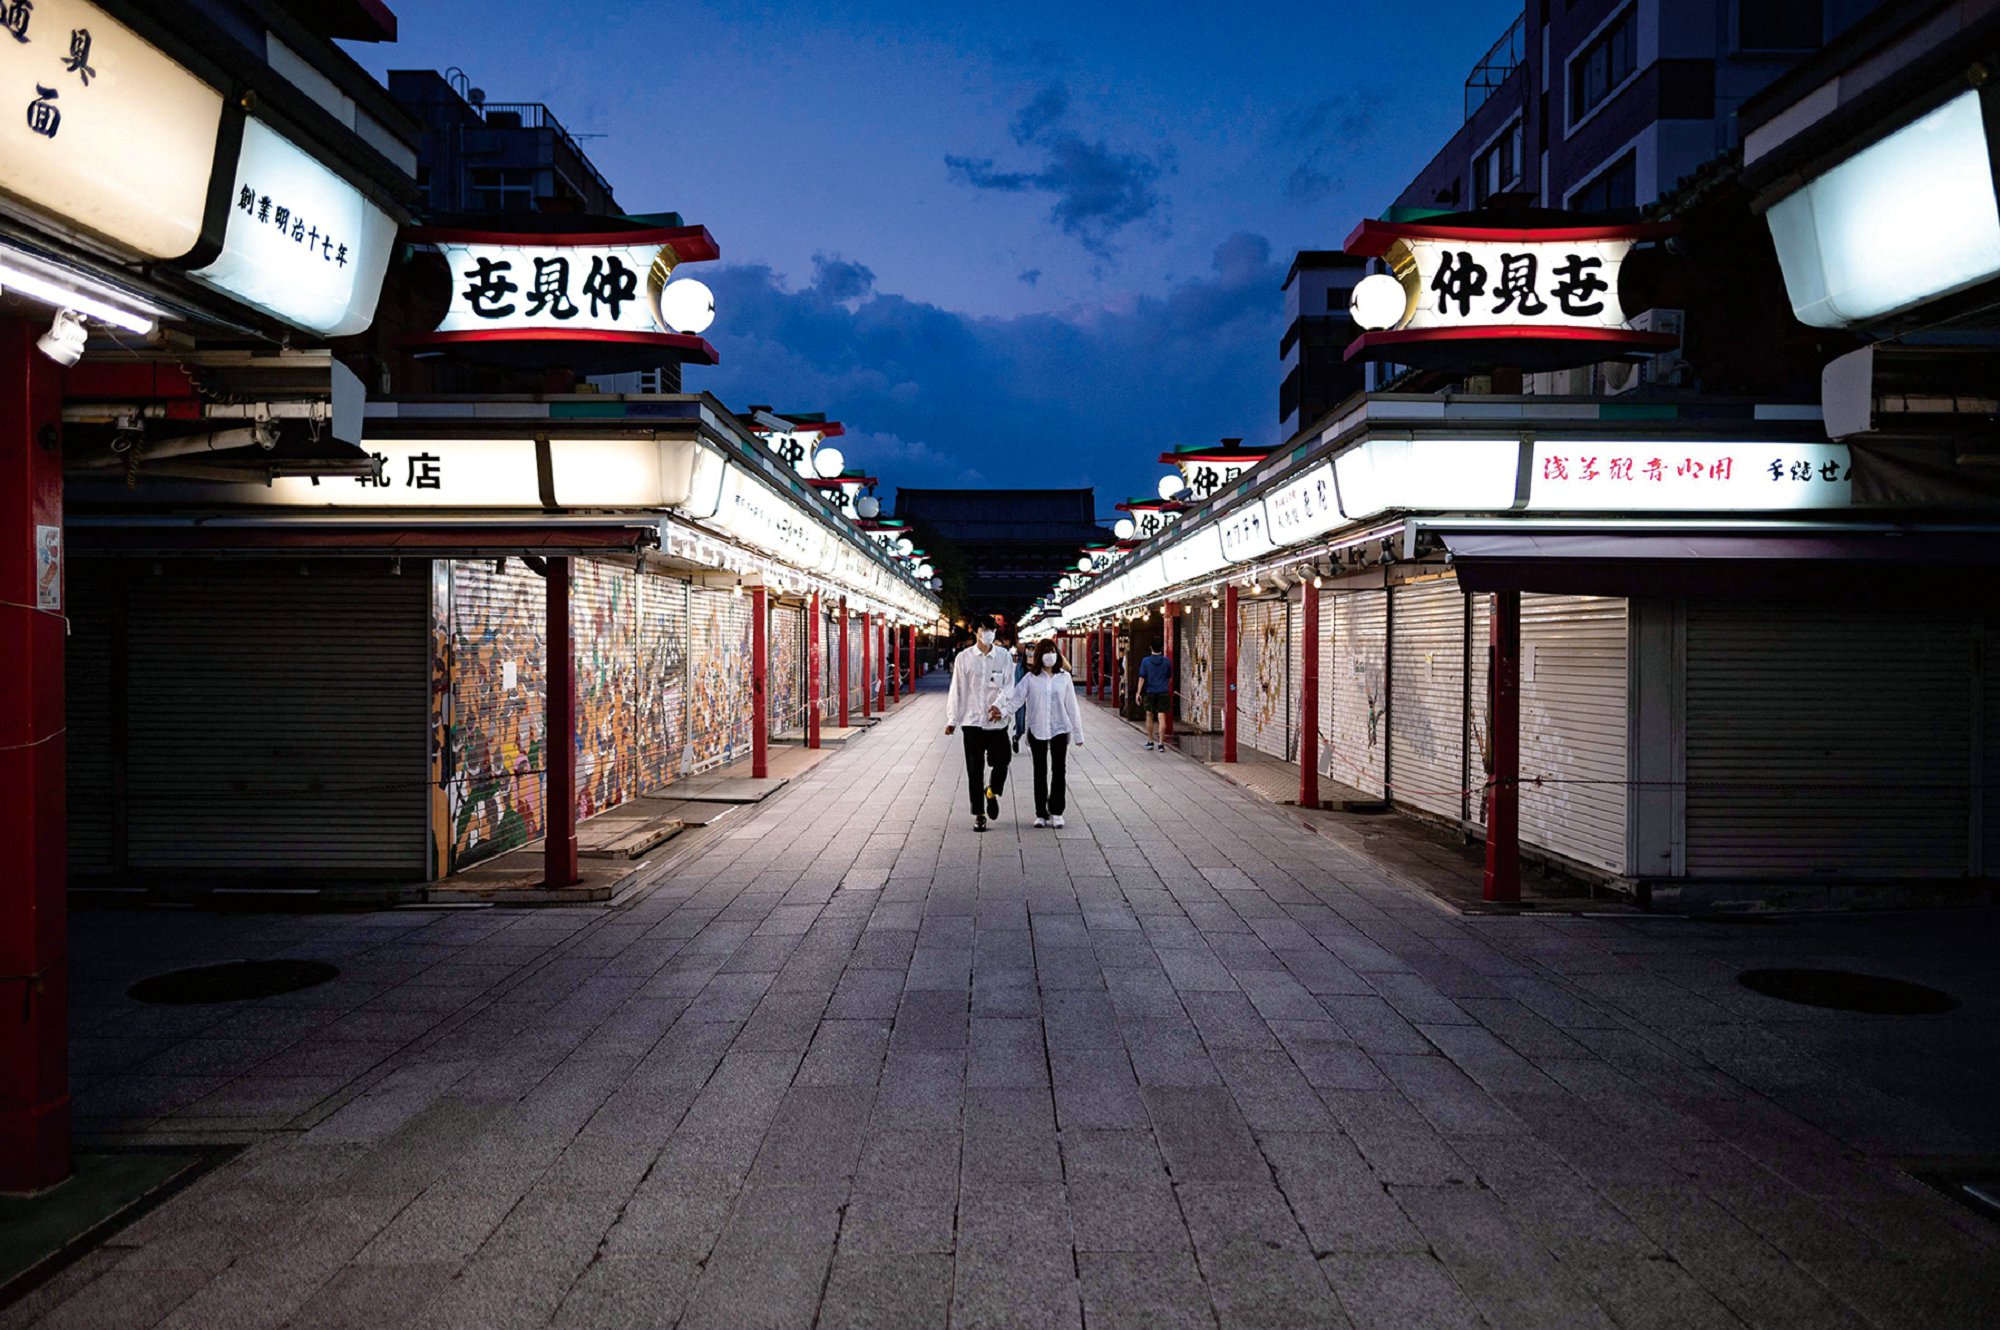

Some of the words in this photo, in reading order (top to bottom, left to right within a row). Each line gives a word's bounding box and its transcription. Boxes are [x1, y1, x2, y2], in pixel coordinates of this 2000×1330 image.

[27, 81, 61, 139] 面
[237, 184, 348, 268] 創業明治十七年
[1431, 250, 1609, 317] 仲見世
